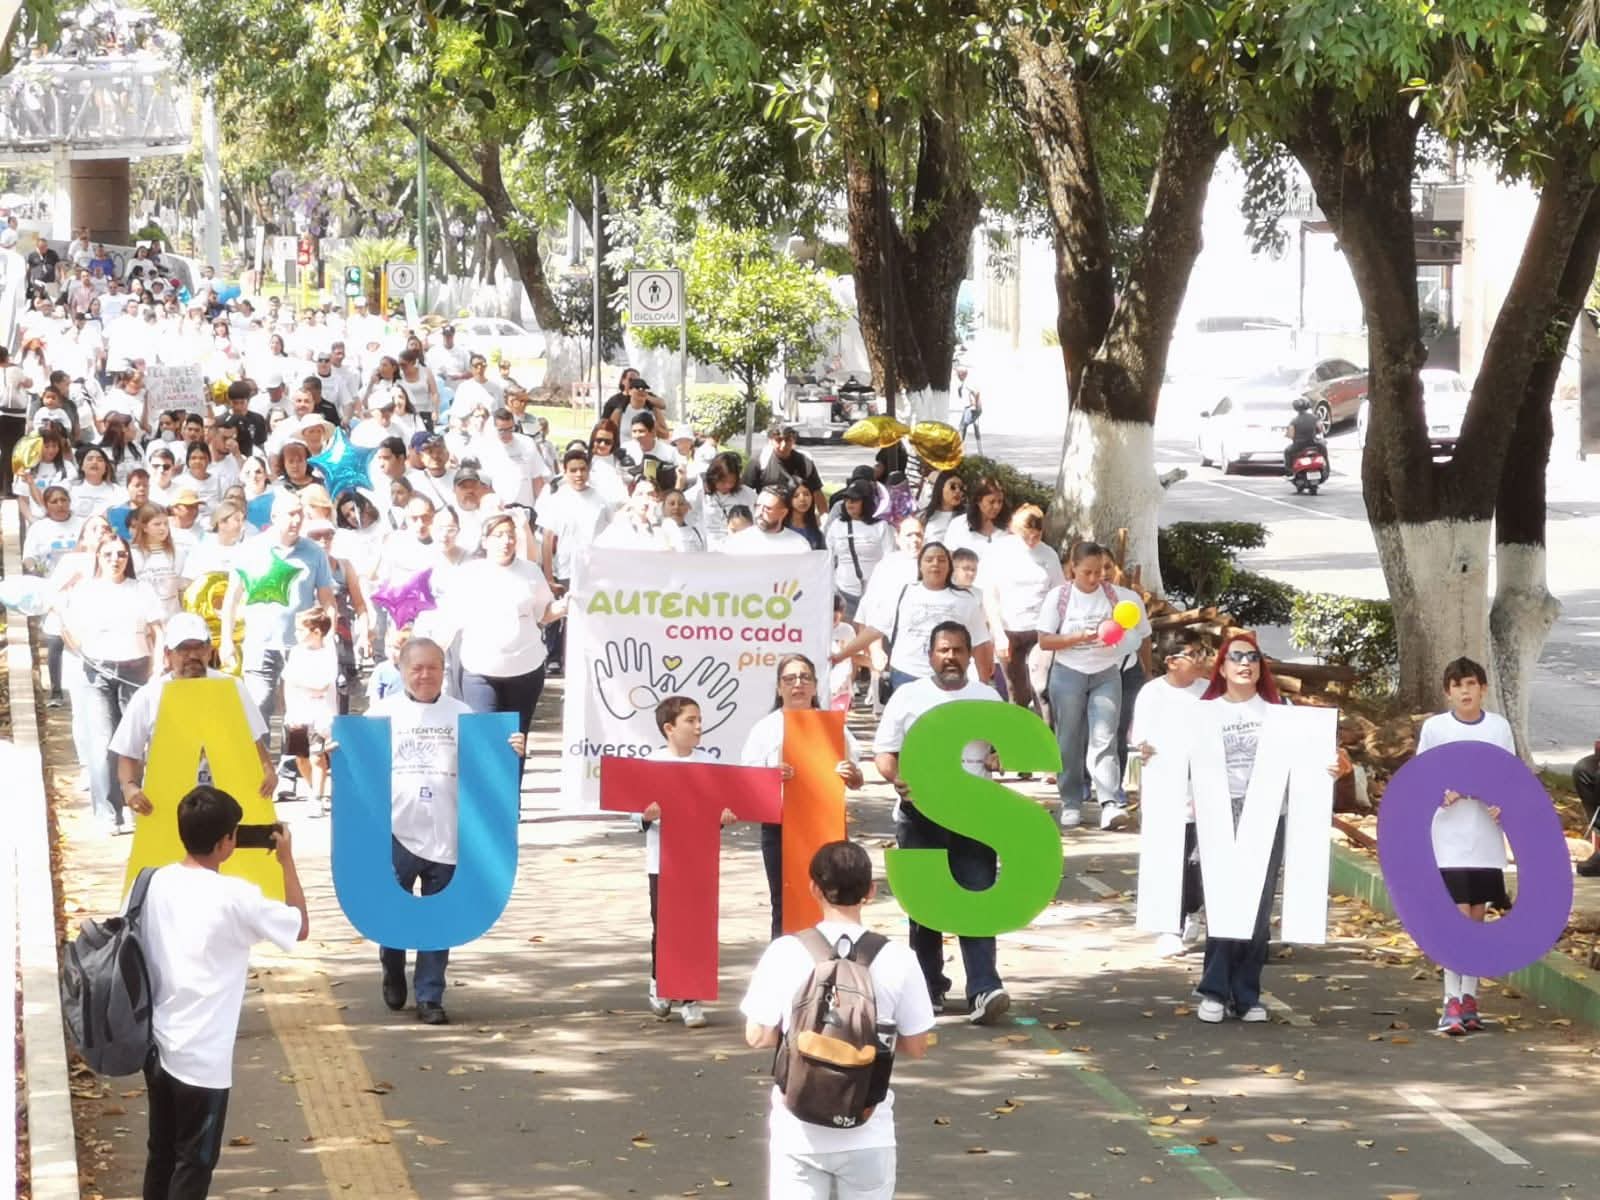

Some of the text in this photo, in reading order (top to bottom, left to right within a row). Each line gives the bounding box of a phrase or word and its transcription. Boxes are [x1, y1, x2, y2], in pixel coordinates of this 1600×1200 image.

[665, 623, 803, 643] como cada
[738, 646, 788, 672] pie
[569, 738, 651, 758] diverso
